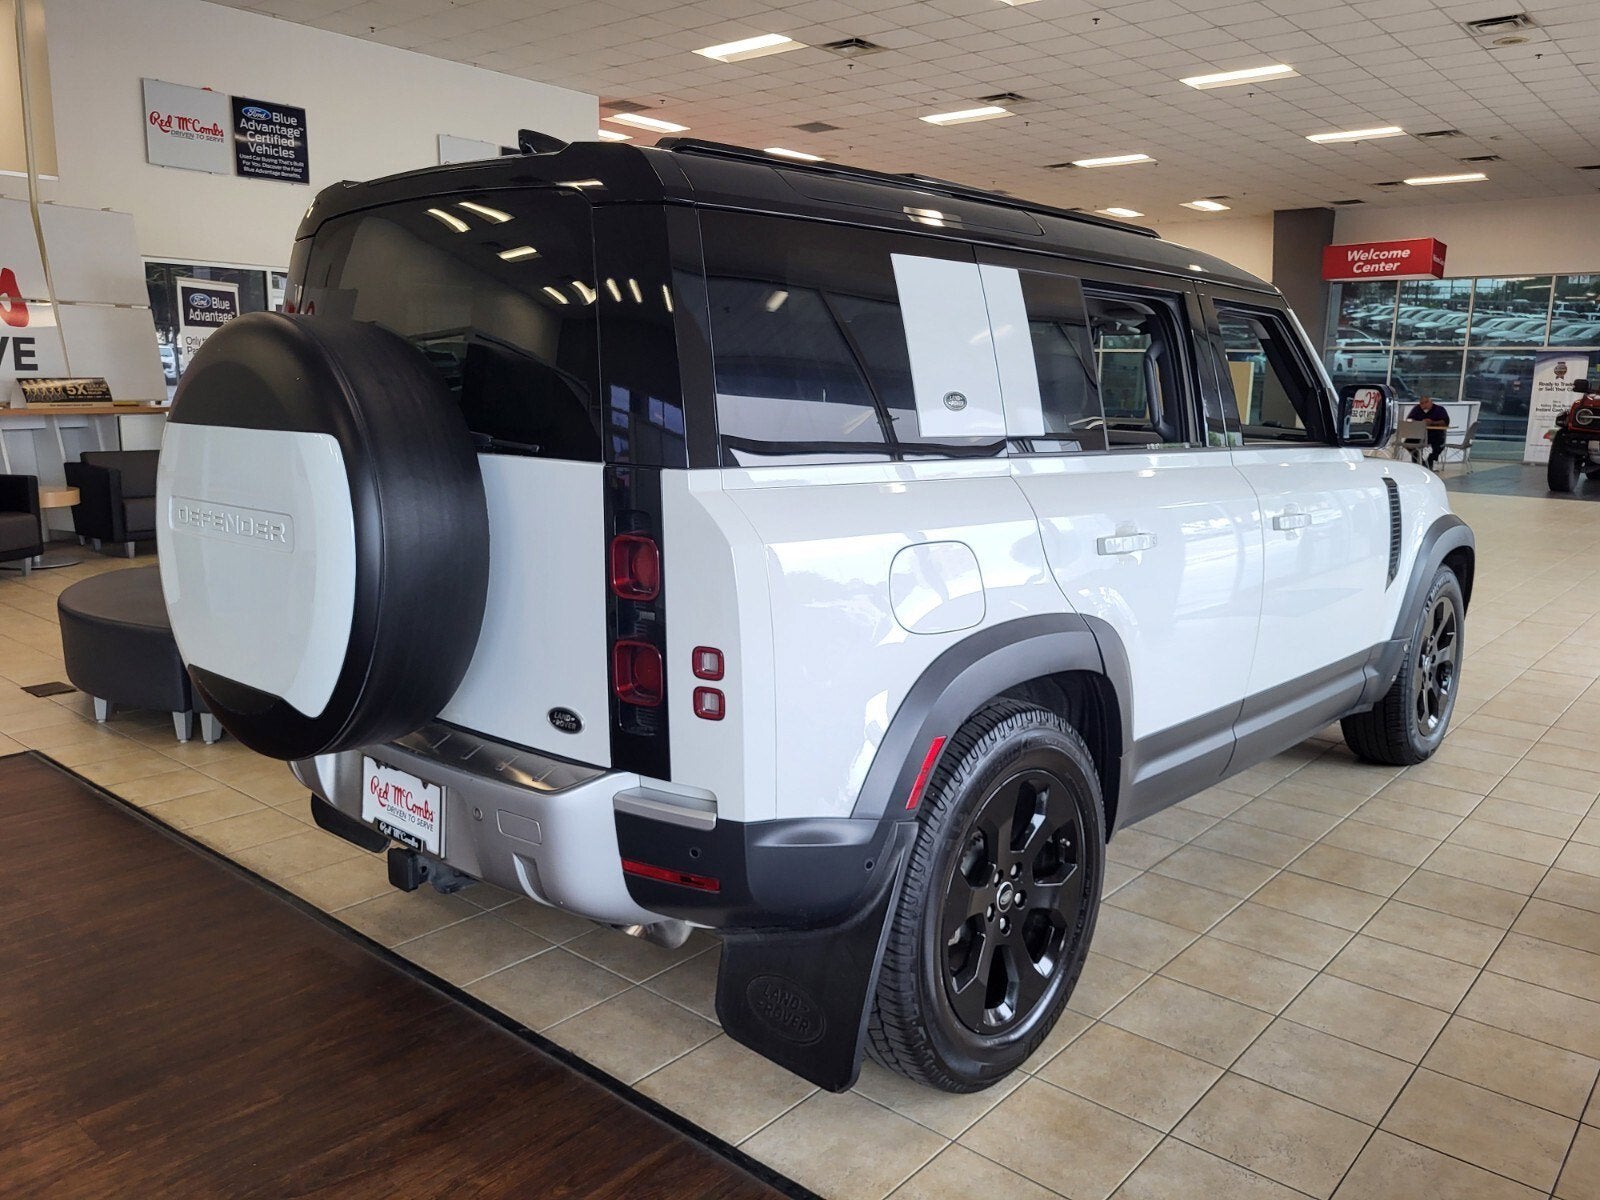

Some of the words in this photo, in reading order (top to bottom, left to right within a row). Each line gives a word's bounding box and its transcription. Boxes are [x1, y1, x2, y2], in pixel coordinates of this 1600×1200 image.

[149, 111, 173, 133] Red
[174, 115, 224, 137] McCombs
[272, 112, 298, 125] Blue
[170, 129, 195, 140] DRIVEN
[206, 135, 225, 143] SERVE
[246, 131, 295, 147] Certified
[248, 142, 295, 158] Vehicles
[1347, 249, 1411, 261] Welcome
[1353, 262, 1401, 273] Center
[212, 297, 230, 309] Blue
[185, 336, 202, 347] Only
[67, 384, 88, 395] 5X
[178, 505, 286, 543] DEFENDER
[554, 711, 571, 722] LAND
[555, 719, 577, 731] ROVER
[370, 776, 390, 807] Red
[391, 785, 434, 822] McCombs
[386, 804, 407, 820] DRIVEN
[408, 814, 416, 823] TO
[417, 817, 434, 832] SERVE
[763, 984, 802, 1010] LAND
[764, 1004, 811, 1036] ROVER
